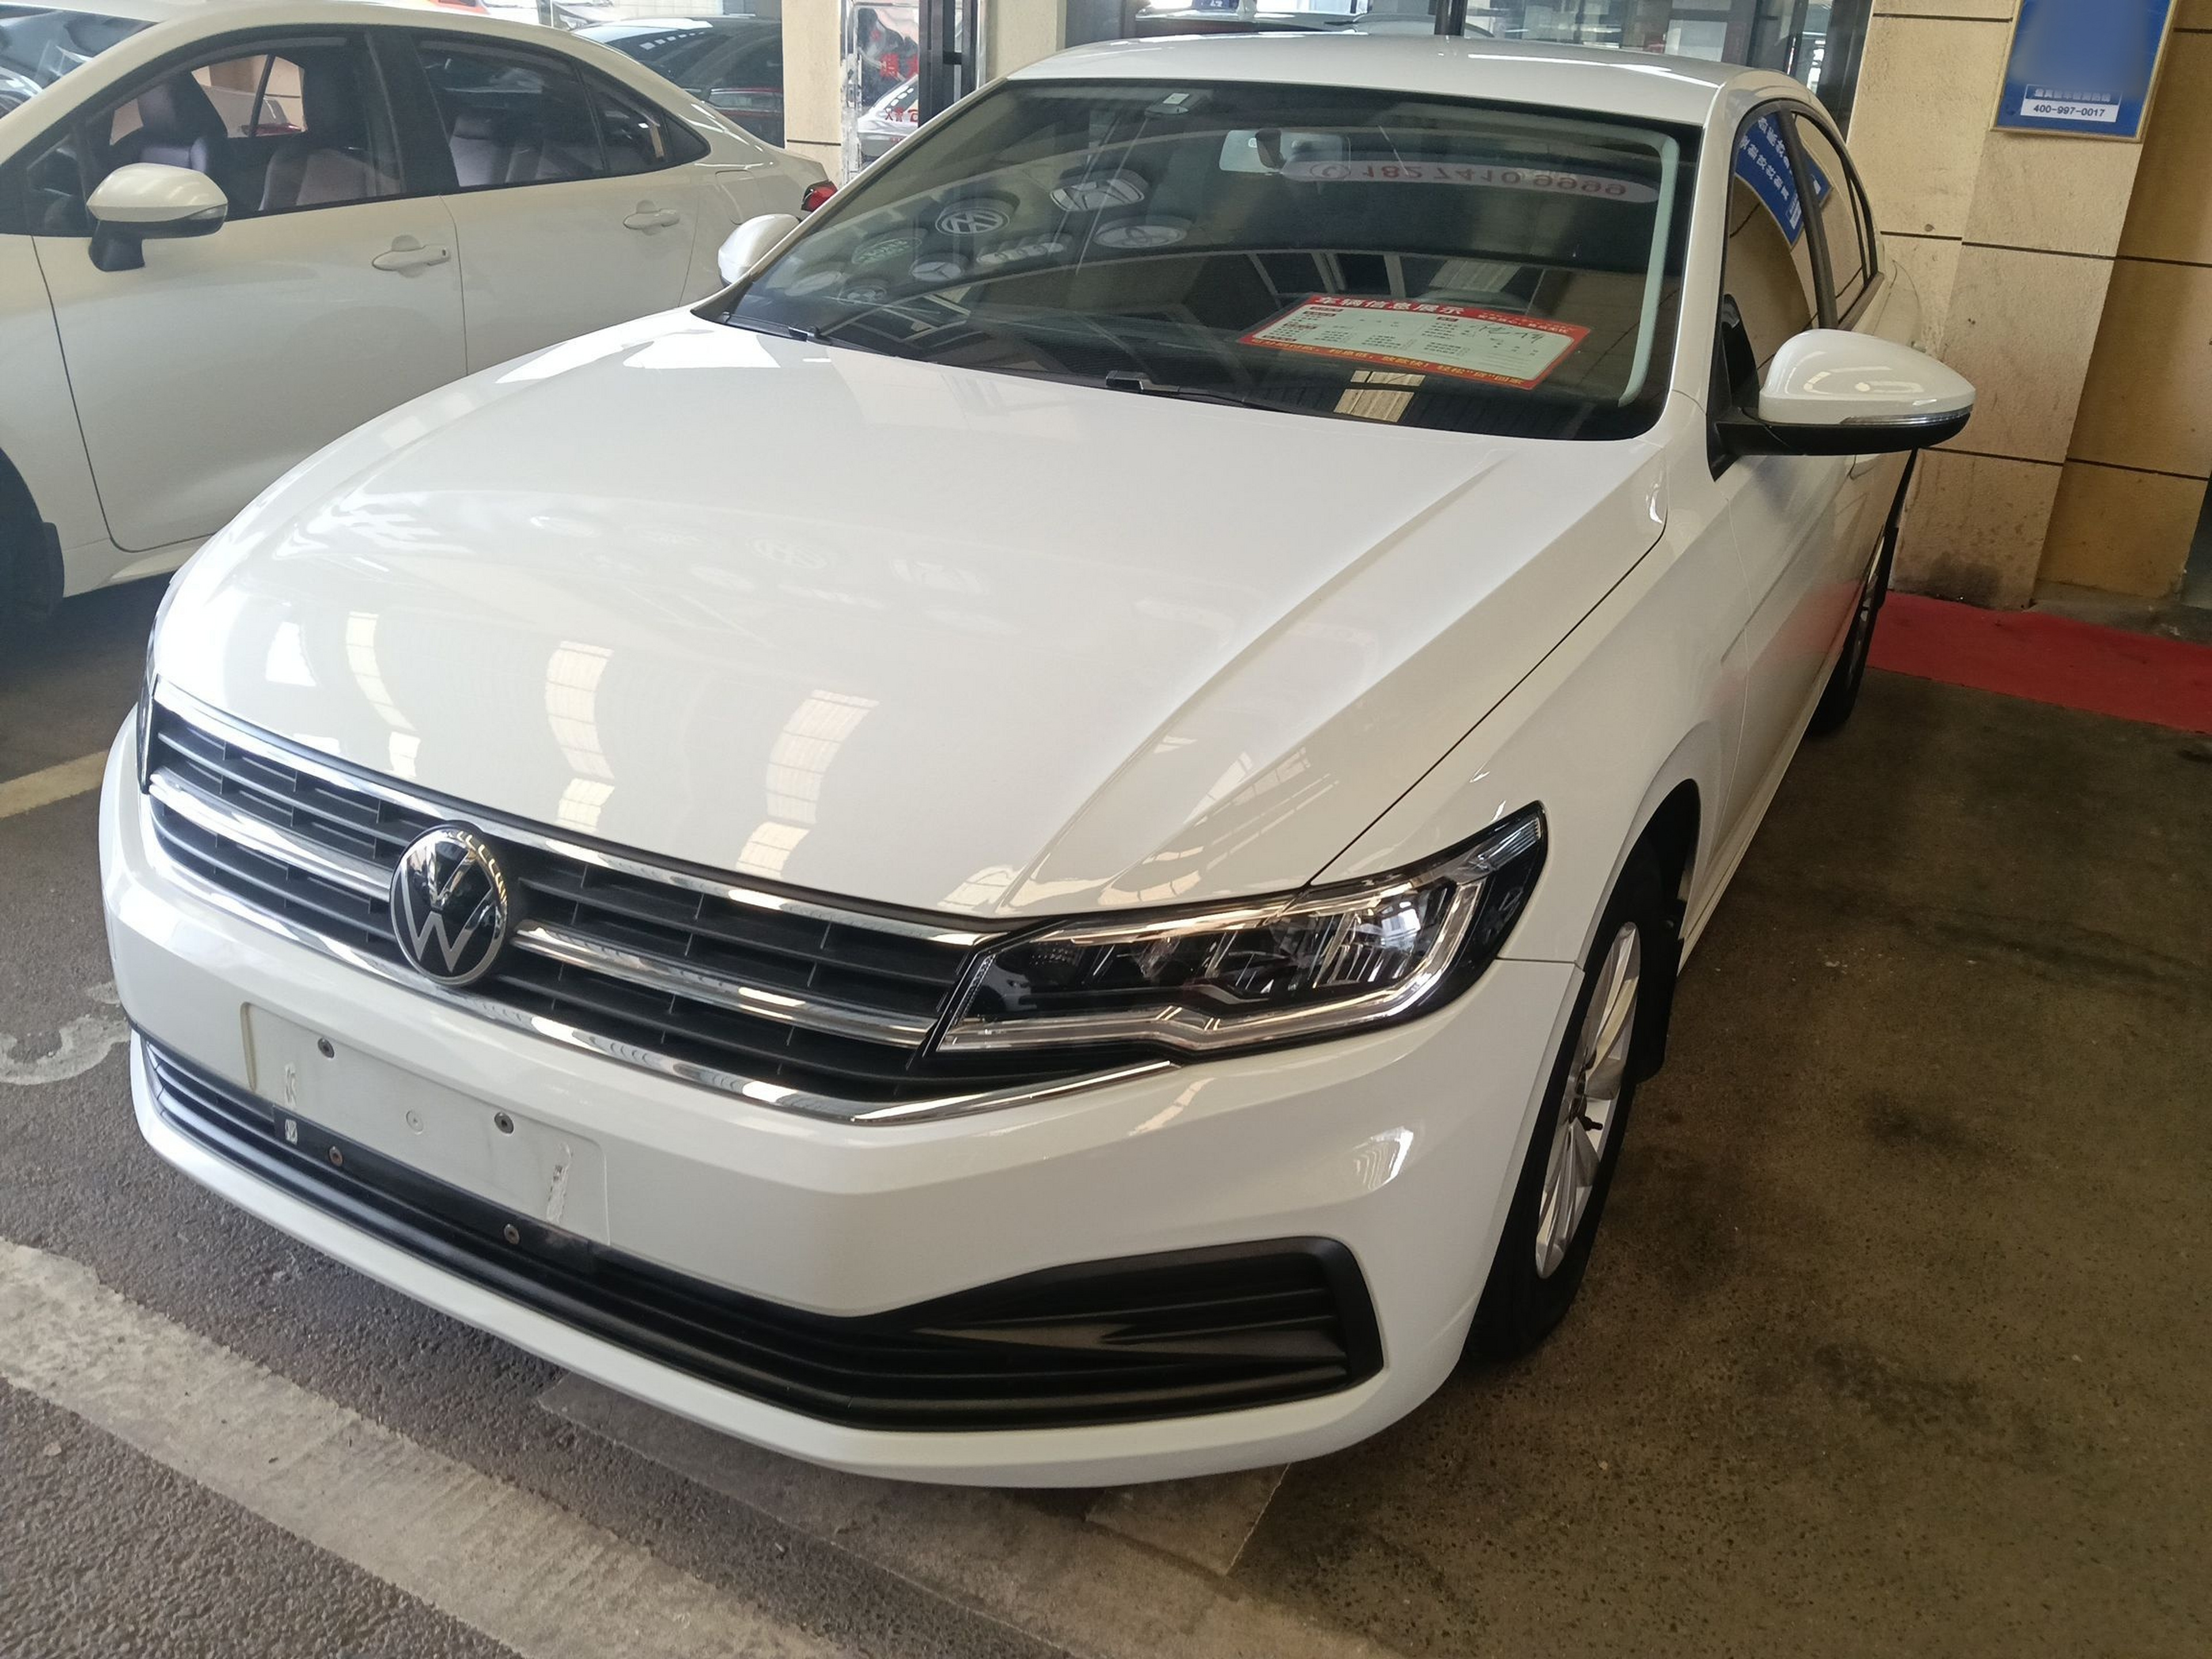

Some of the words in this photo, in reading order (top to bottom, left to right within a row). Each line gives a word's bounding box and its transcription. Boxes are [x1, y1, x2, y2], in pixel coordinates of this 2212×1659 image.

[2033, 104, 2105, 117] 400-997-0017
[1315, 296, 1465, 315] 车辆信息展示
